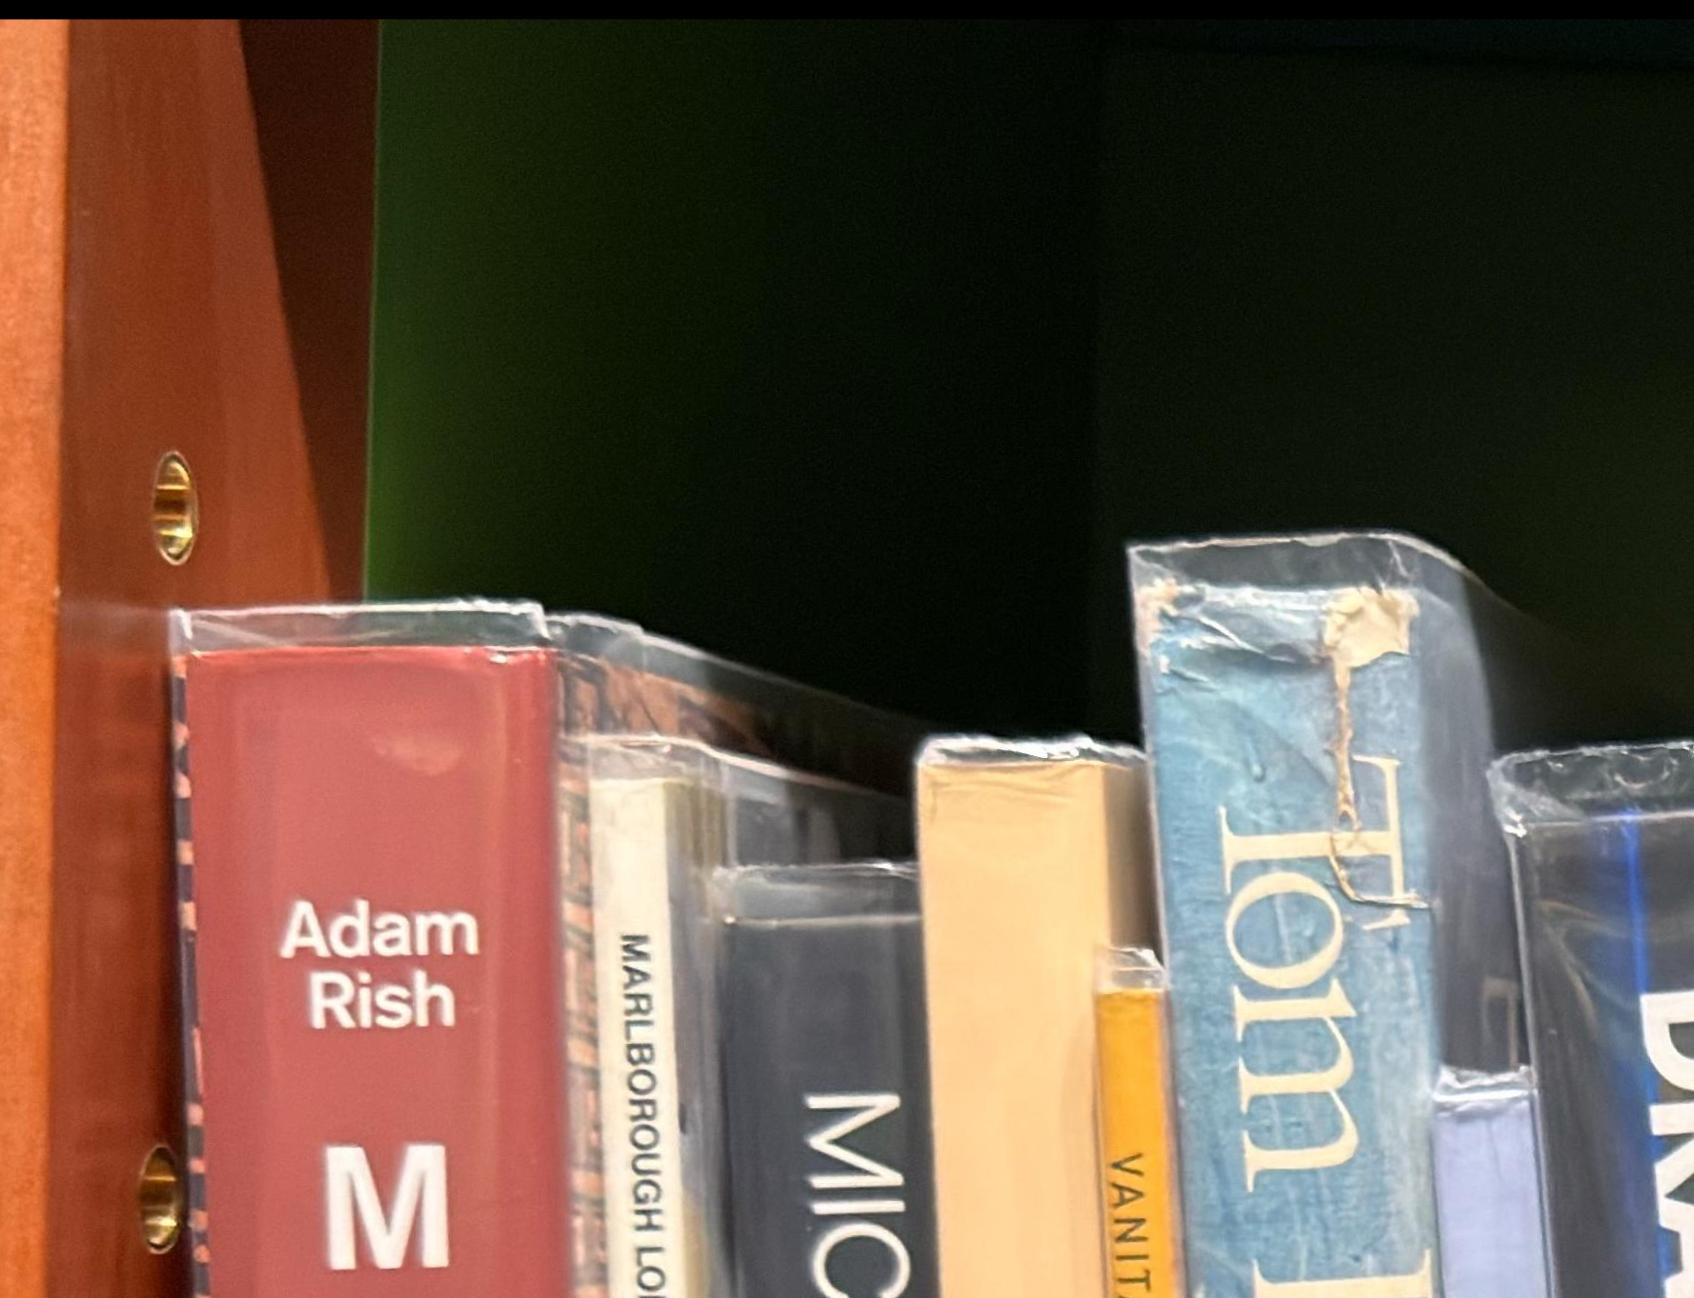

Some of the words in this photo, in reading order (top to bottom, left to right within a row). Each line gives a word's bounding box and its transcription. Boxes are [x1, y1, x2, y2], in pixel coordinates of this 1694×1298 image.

[279, 899, 480, 959] Adam
[309, 970, 456, 1030] Rish
[1219, 756, 1412, 1193] Tom
[619, 934, 662, 1233] MARLBOROUGH
